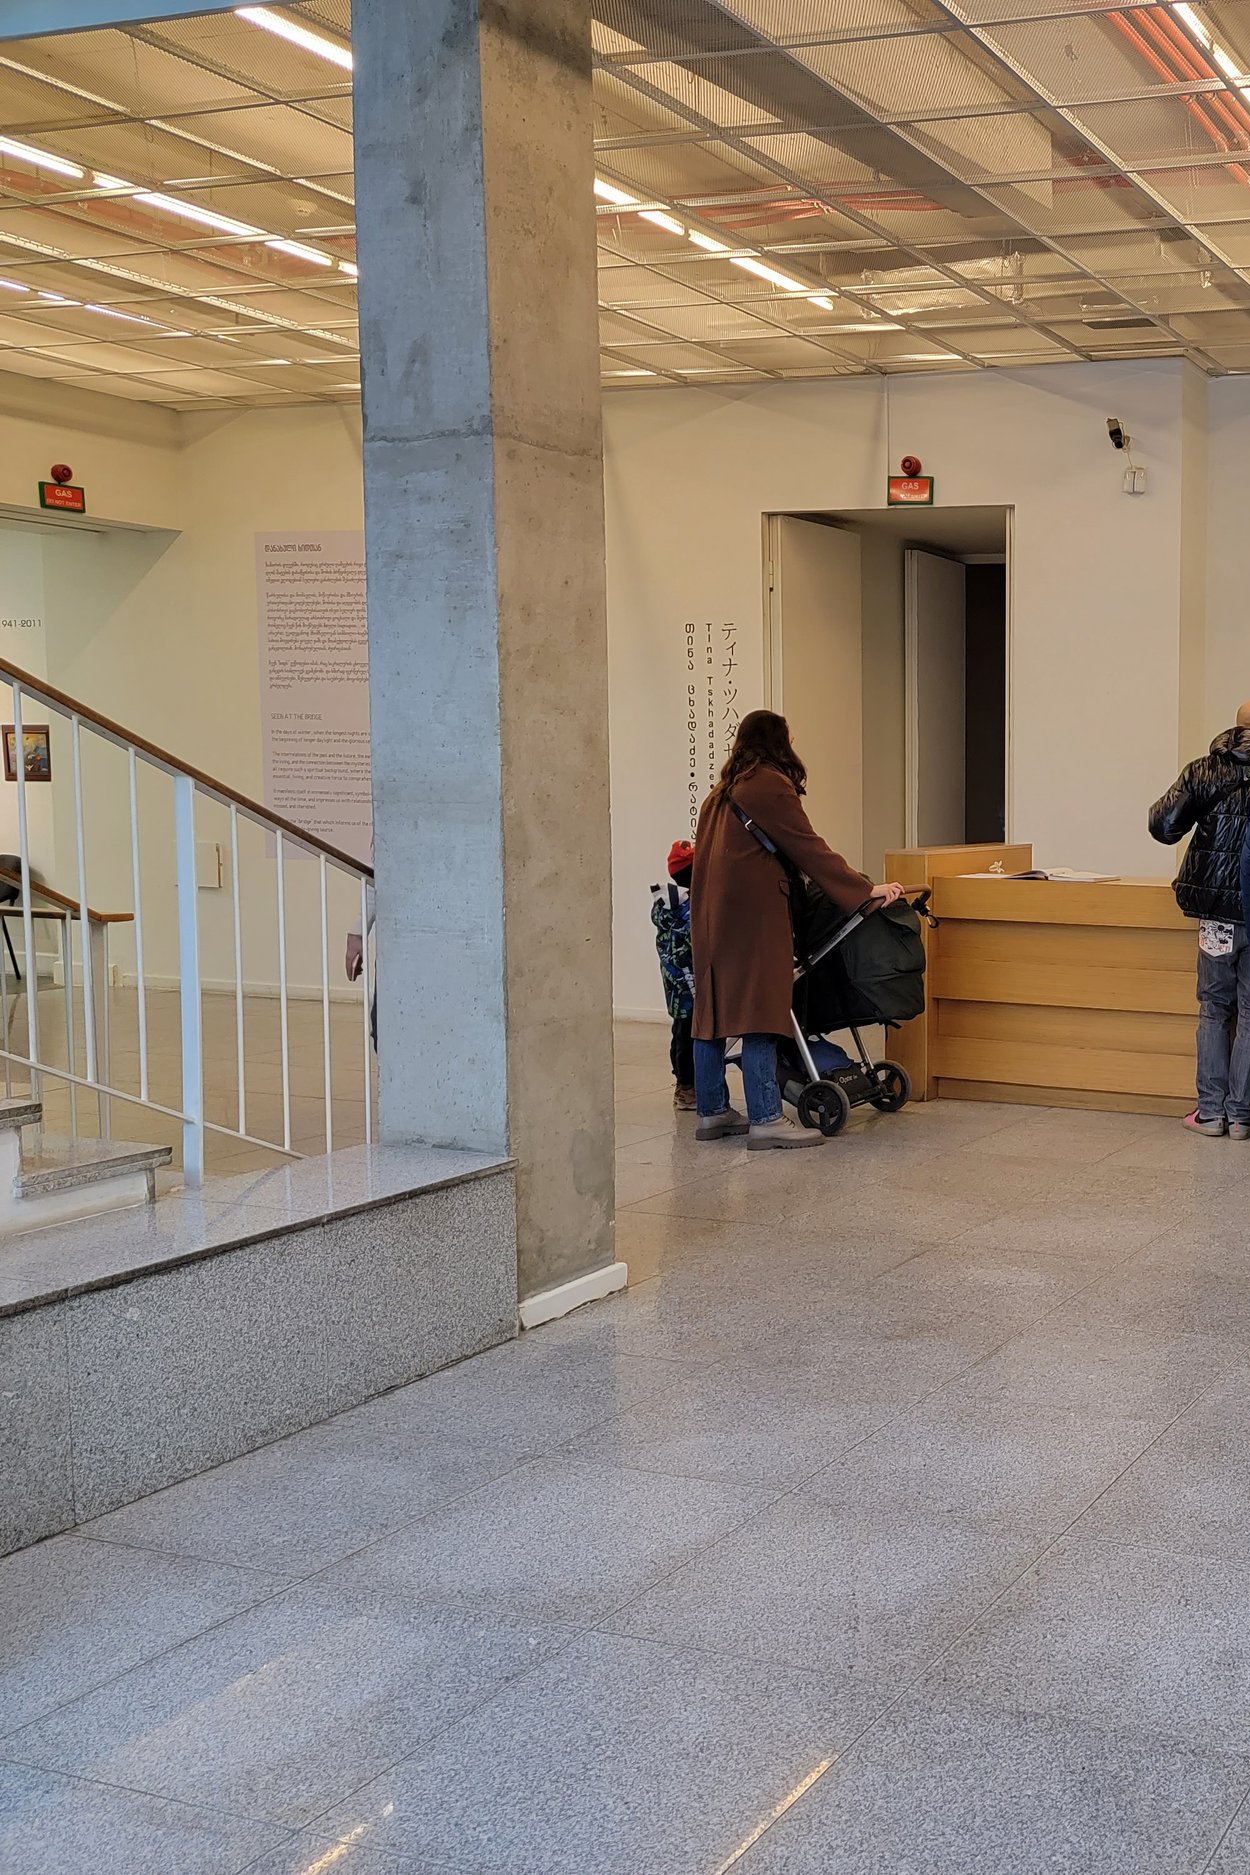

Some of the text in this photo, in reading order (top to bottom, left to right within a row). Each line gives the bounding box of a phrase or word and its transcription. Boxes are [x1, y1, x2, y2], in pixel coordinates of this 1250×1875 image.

[55, 490, 72, 498] GAS
[2, 619, 42, 628] 941-2011
[685, 623, 695, 670] თინა
